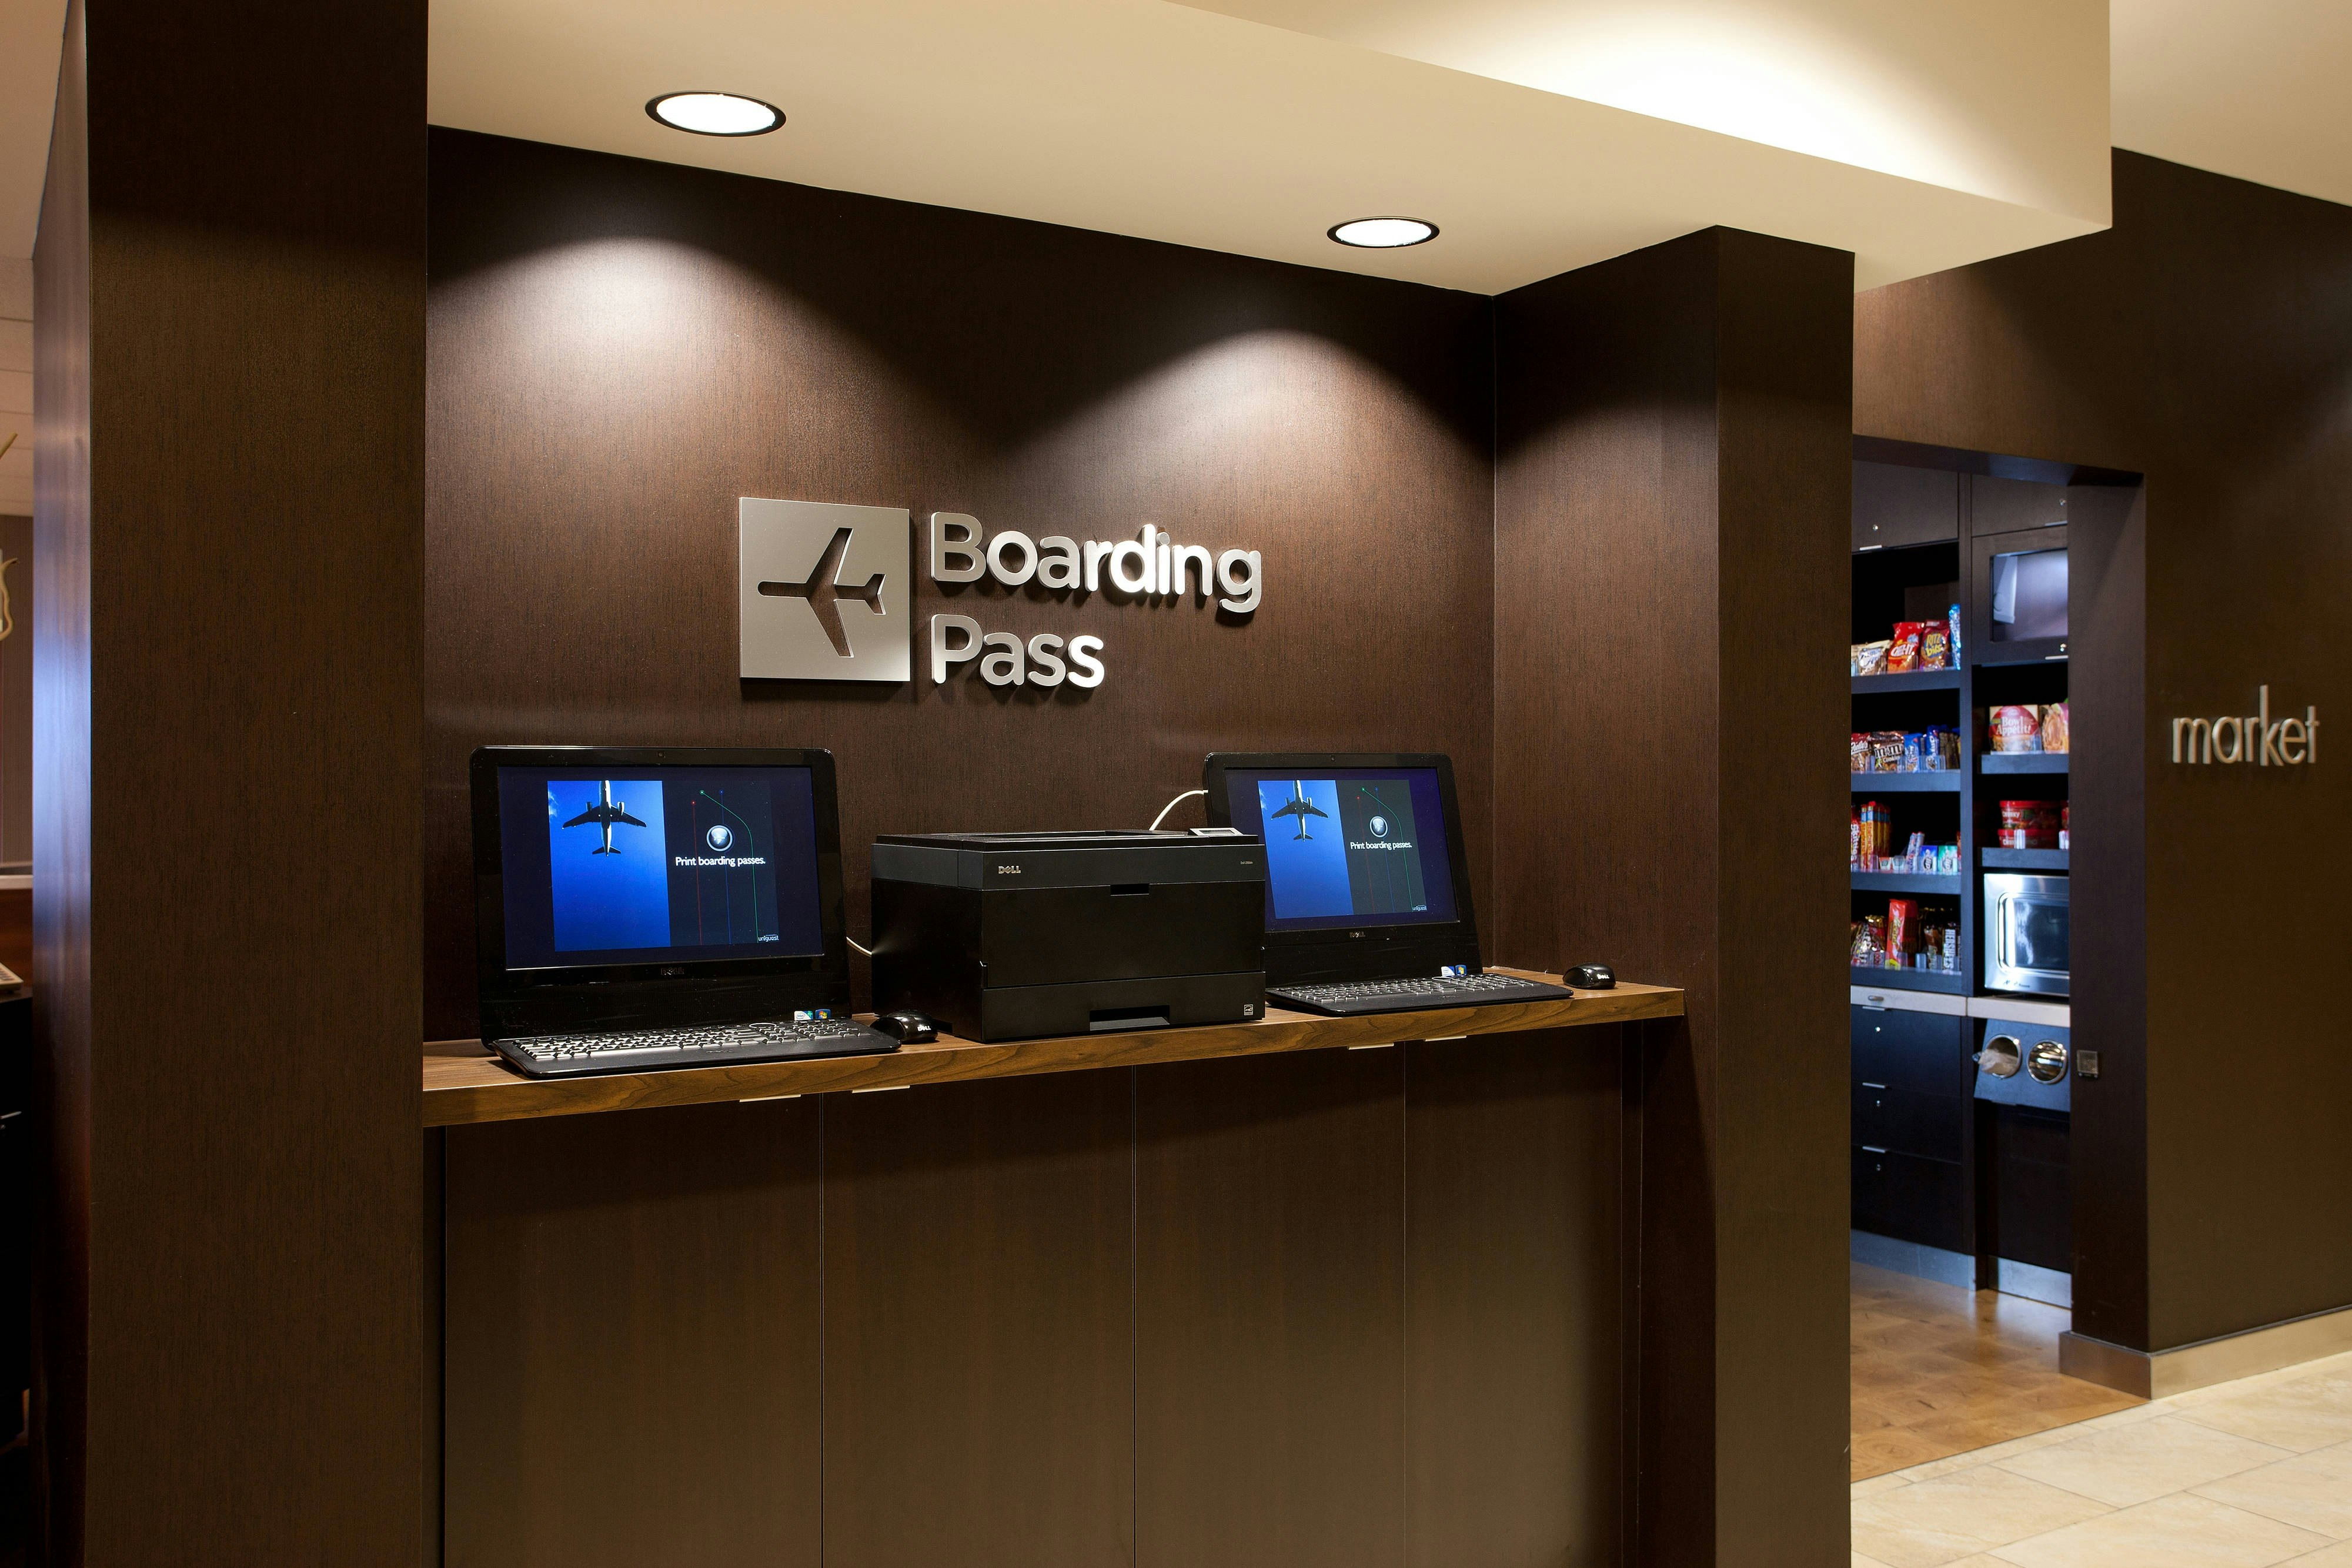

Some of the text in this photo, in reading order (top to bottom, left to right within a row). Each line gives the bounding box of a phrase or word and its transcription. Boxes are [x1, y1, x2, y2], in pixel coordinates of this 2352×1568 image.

[931, 511, 1261, 613] Boarding
[931, 614, 1105, 688] Pass
[2002, 716, 2023, 727] Bowl
[2173, 684, 2320, 766] market
[1350, 841, 1412, 850] Print boarding passes.
[675, 856, 766, 867] Print boarding passes.
[998, 865, 1021, 874] DELL
